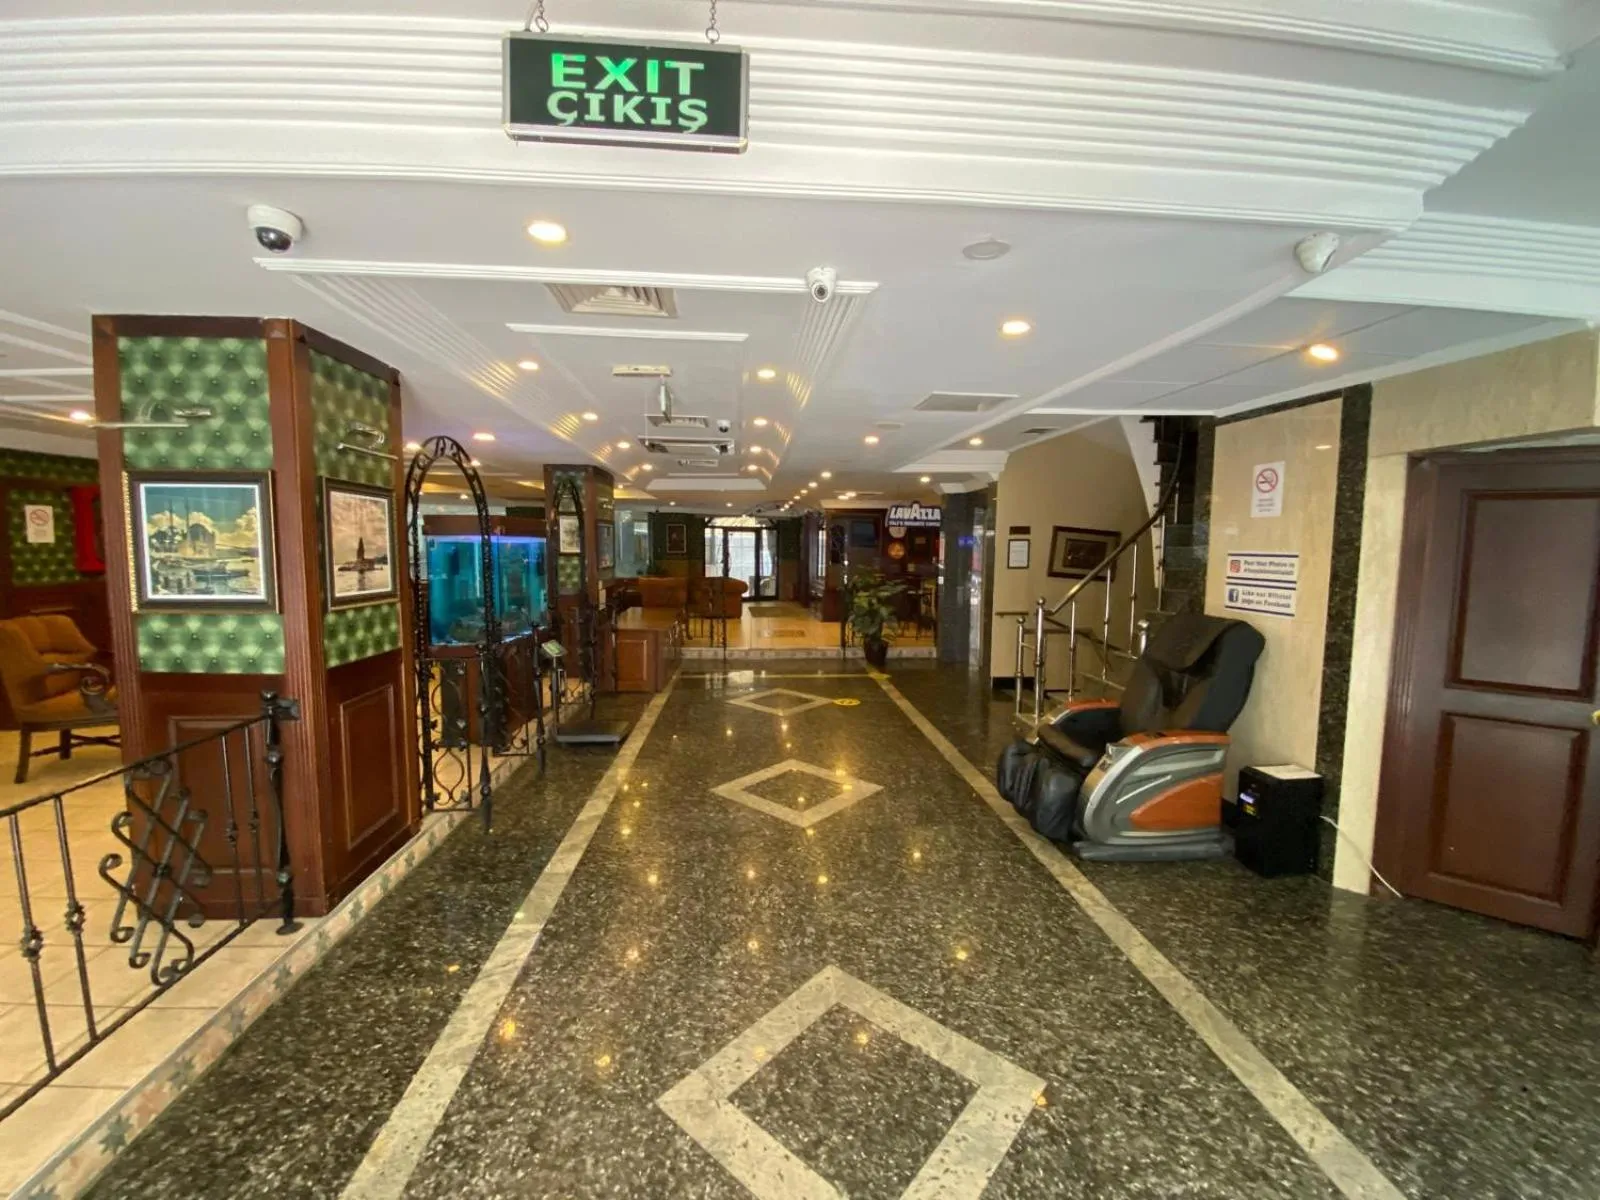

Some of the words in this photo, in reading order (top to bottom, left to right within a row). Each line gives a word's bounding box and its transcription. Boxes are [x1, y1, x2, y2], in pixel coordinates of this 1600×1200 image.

[550, 53, 705, 96] EXIT
[547, 90, 708, 134] ÇIKIŞ
[890, 503, 941, 520] LAVAZZA
